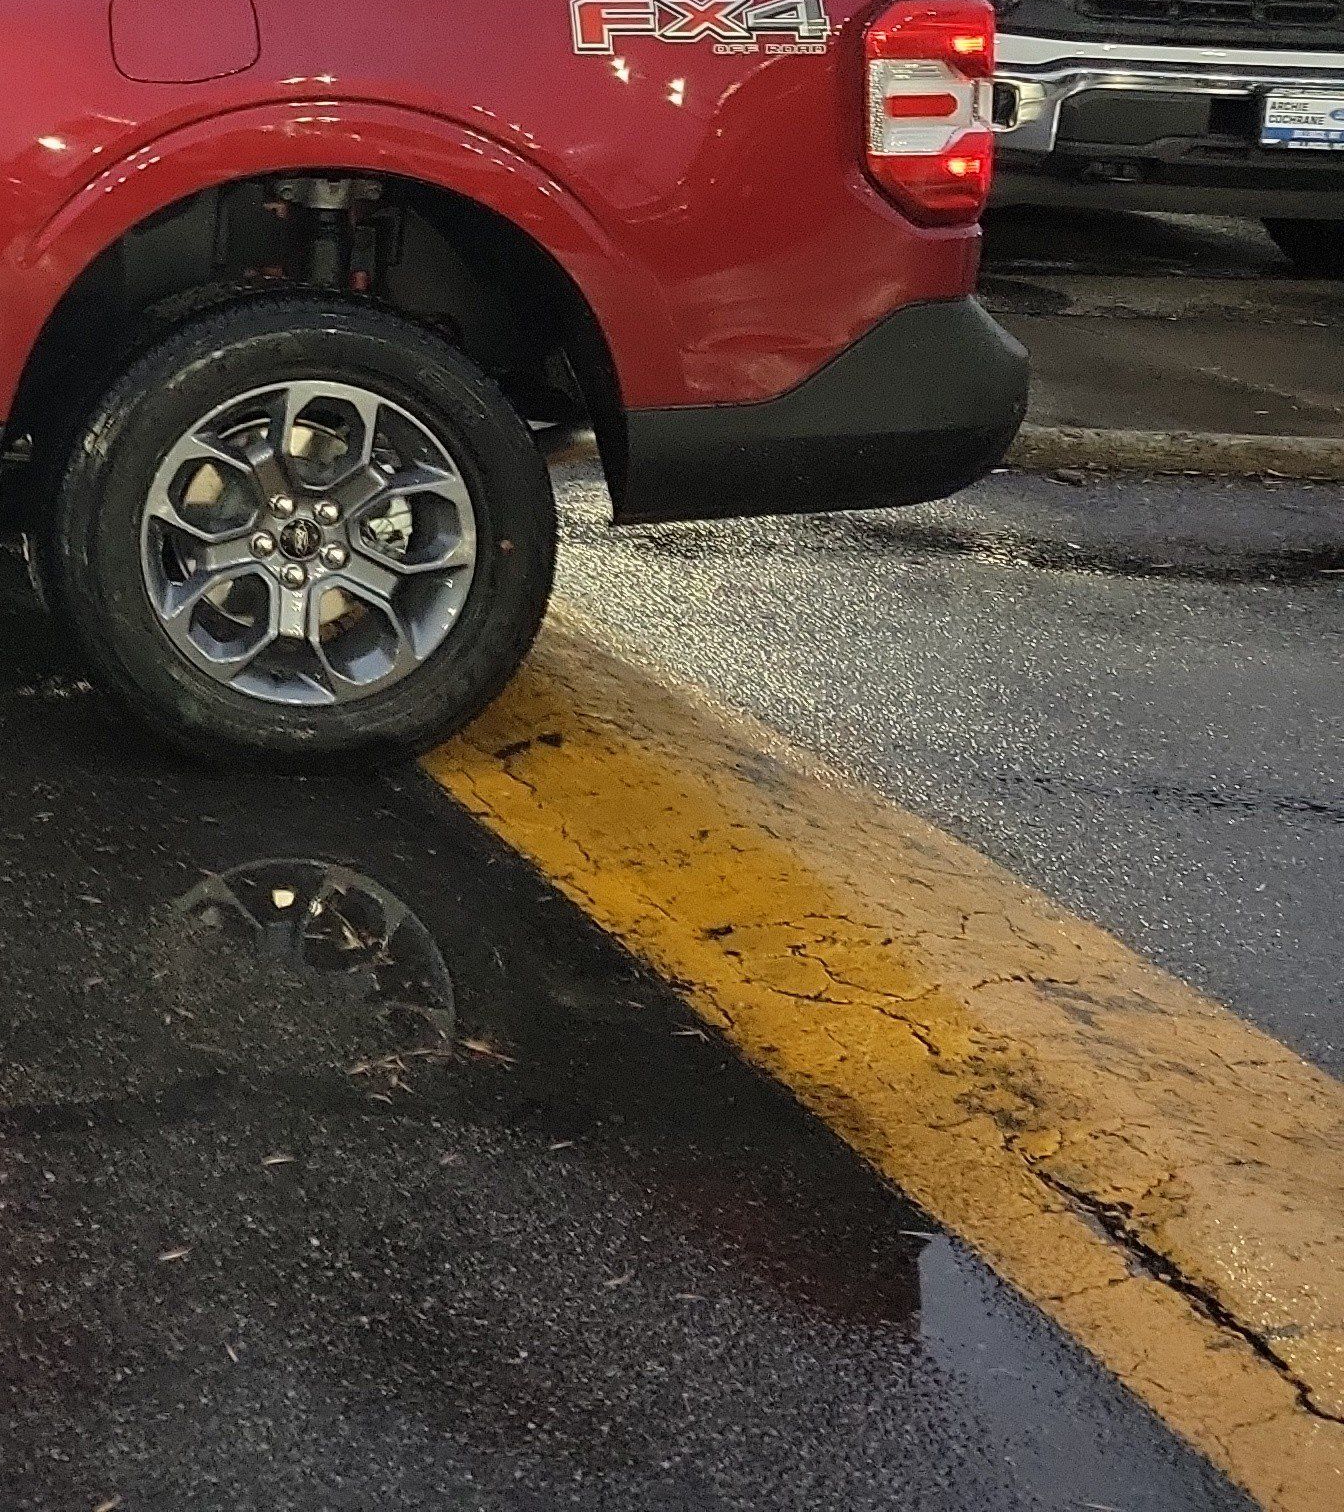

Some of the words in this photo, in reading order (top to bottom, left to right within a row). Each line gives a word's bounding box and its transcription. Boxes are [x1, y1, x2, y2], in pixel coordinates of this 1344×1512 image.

[713, 43, 759, 55] OFF
[764, 43, 827, 55] ROAD
[1270, 101, 1309, 112] ARCHIE
[1268, 114, 1326, 125] COCHRANE
